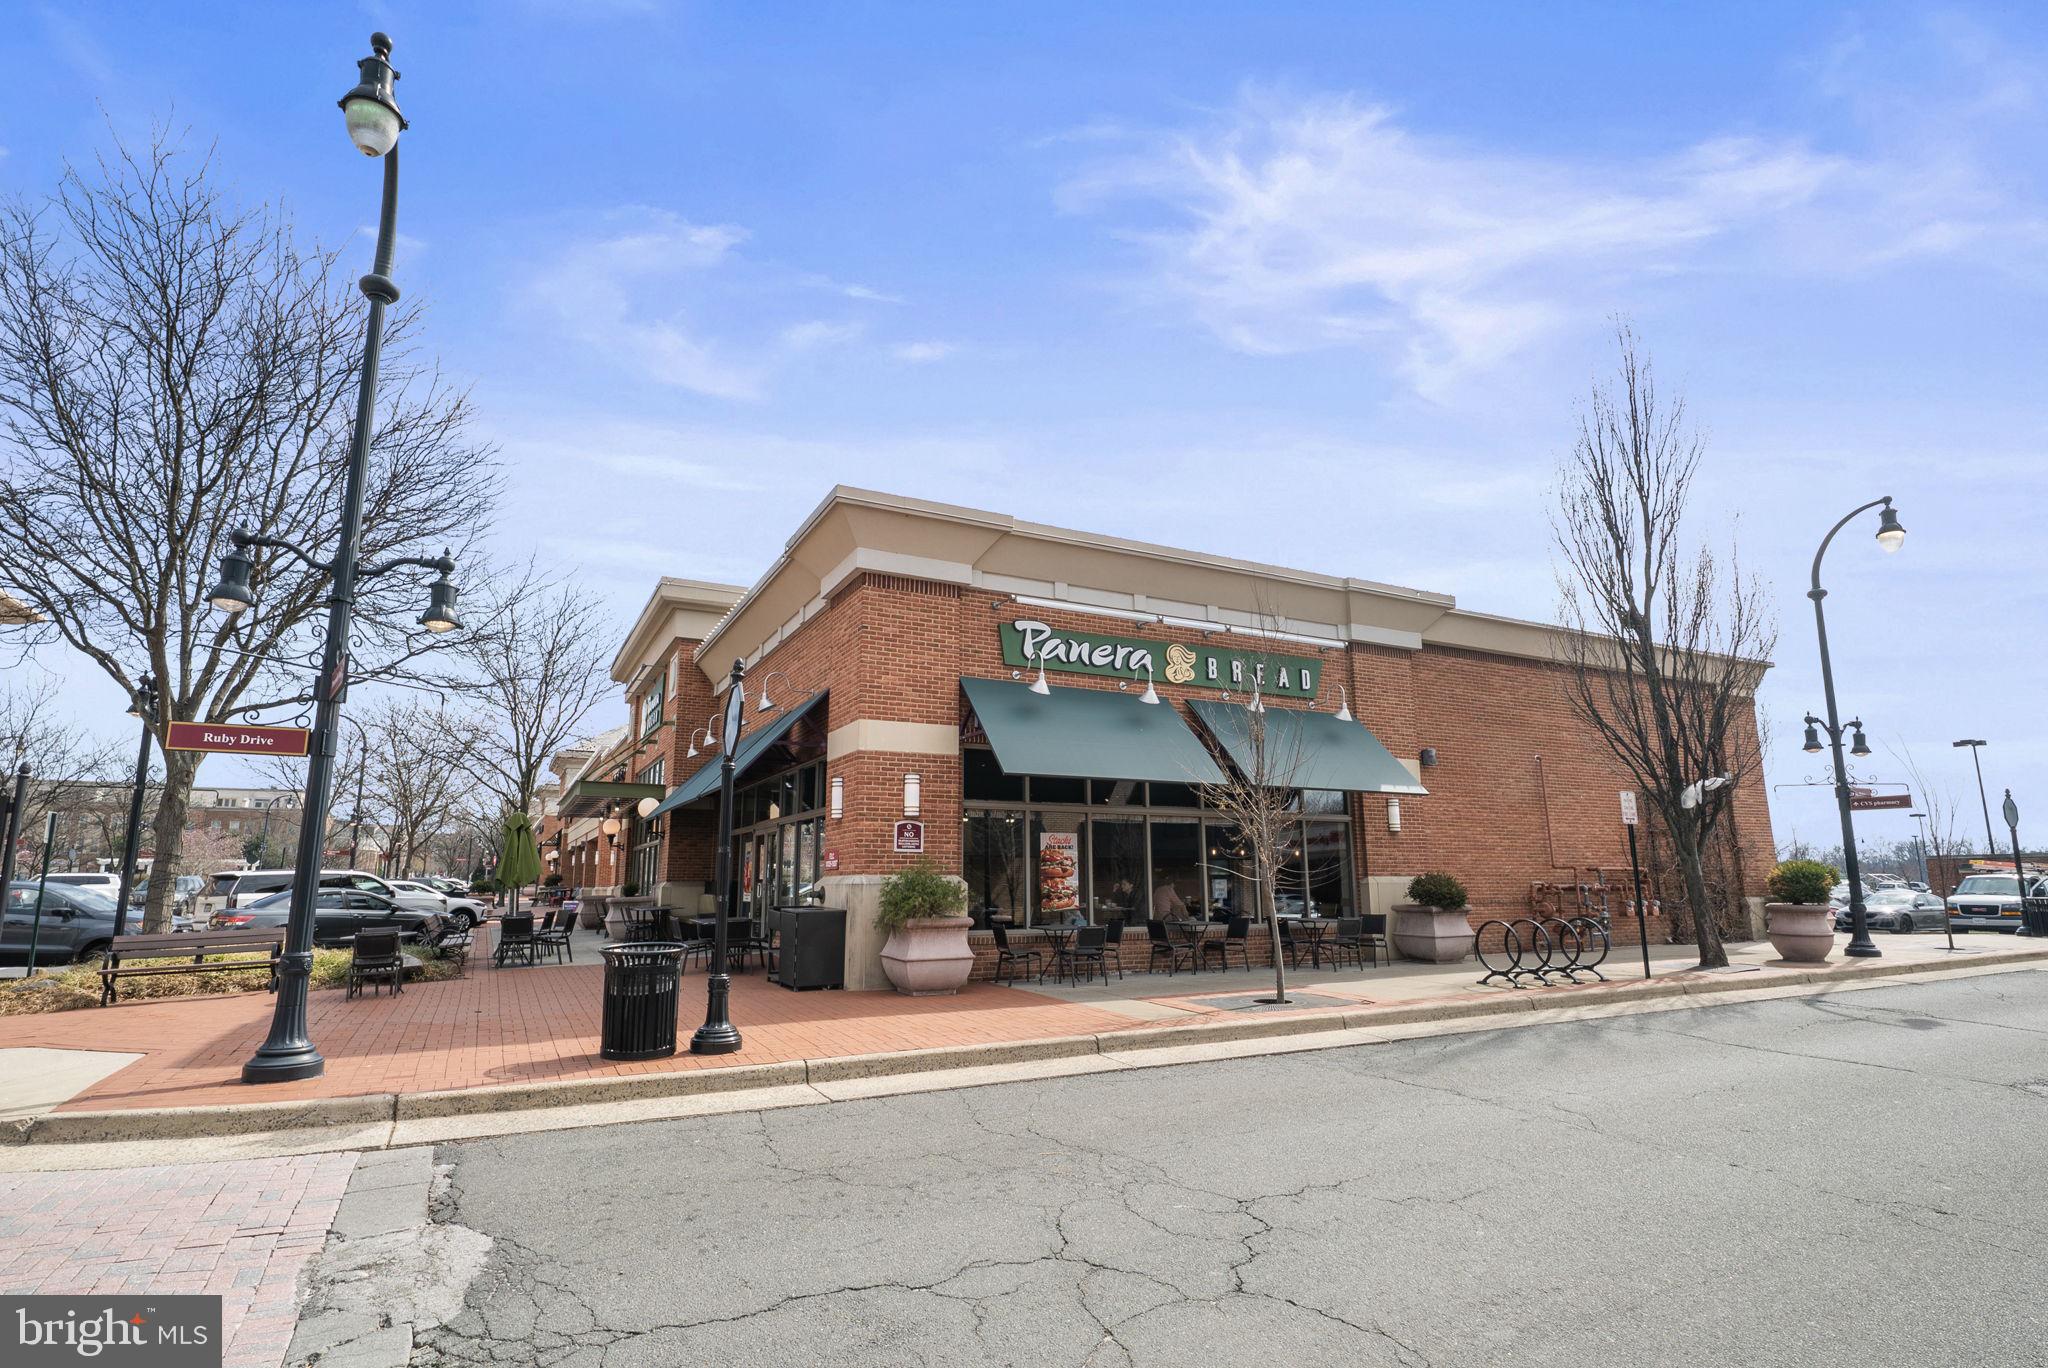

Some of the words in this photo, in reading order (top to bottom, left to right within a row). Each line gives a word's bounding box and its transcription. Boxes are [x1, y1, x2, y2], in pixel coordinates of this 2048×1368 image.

[1014, 620, 1153, 672] Panera
[1206, 656, 1312, 691] BREAD
[203, 732, 236, 745] Ruby
[240, 734, 274, 745] Drive
